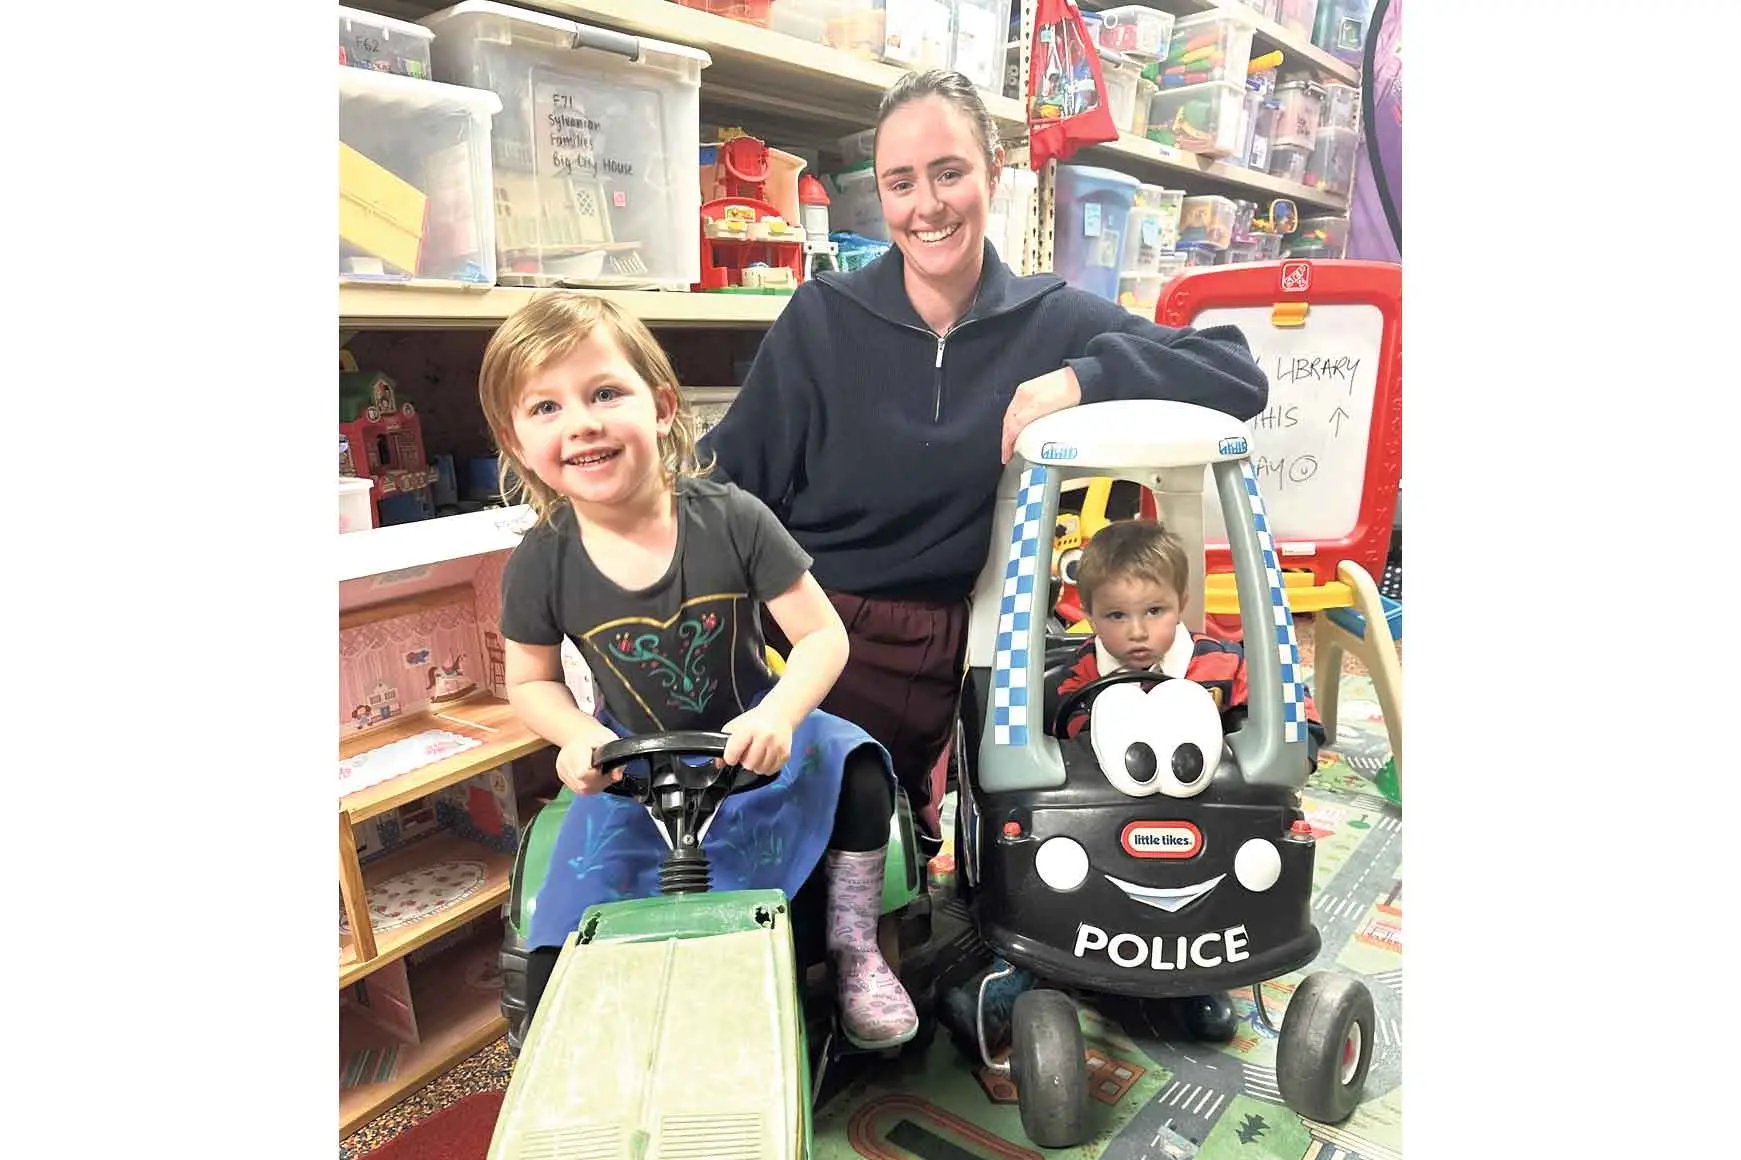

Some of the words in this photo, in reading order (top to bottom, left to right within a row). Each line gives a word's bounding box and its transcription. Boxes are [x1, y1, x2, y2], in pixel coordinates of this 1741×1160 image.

[552, 93, 574, 109] F71
[548, 113, 602, 132] Sylvanian
[552, 151, 572, 175] Big
[1277, 356, 1360, 396] LIBRARY
[1256, 455, 1285, 490] AY
[1134, 834, 1161, 845] little
[1074, 922, 1250, 970] POLICE
